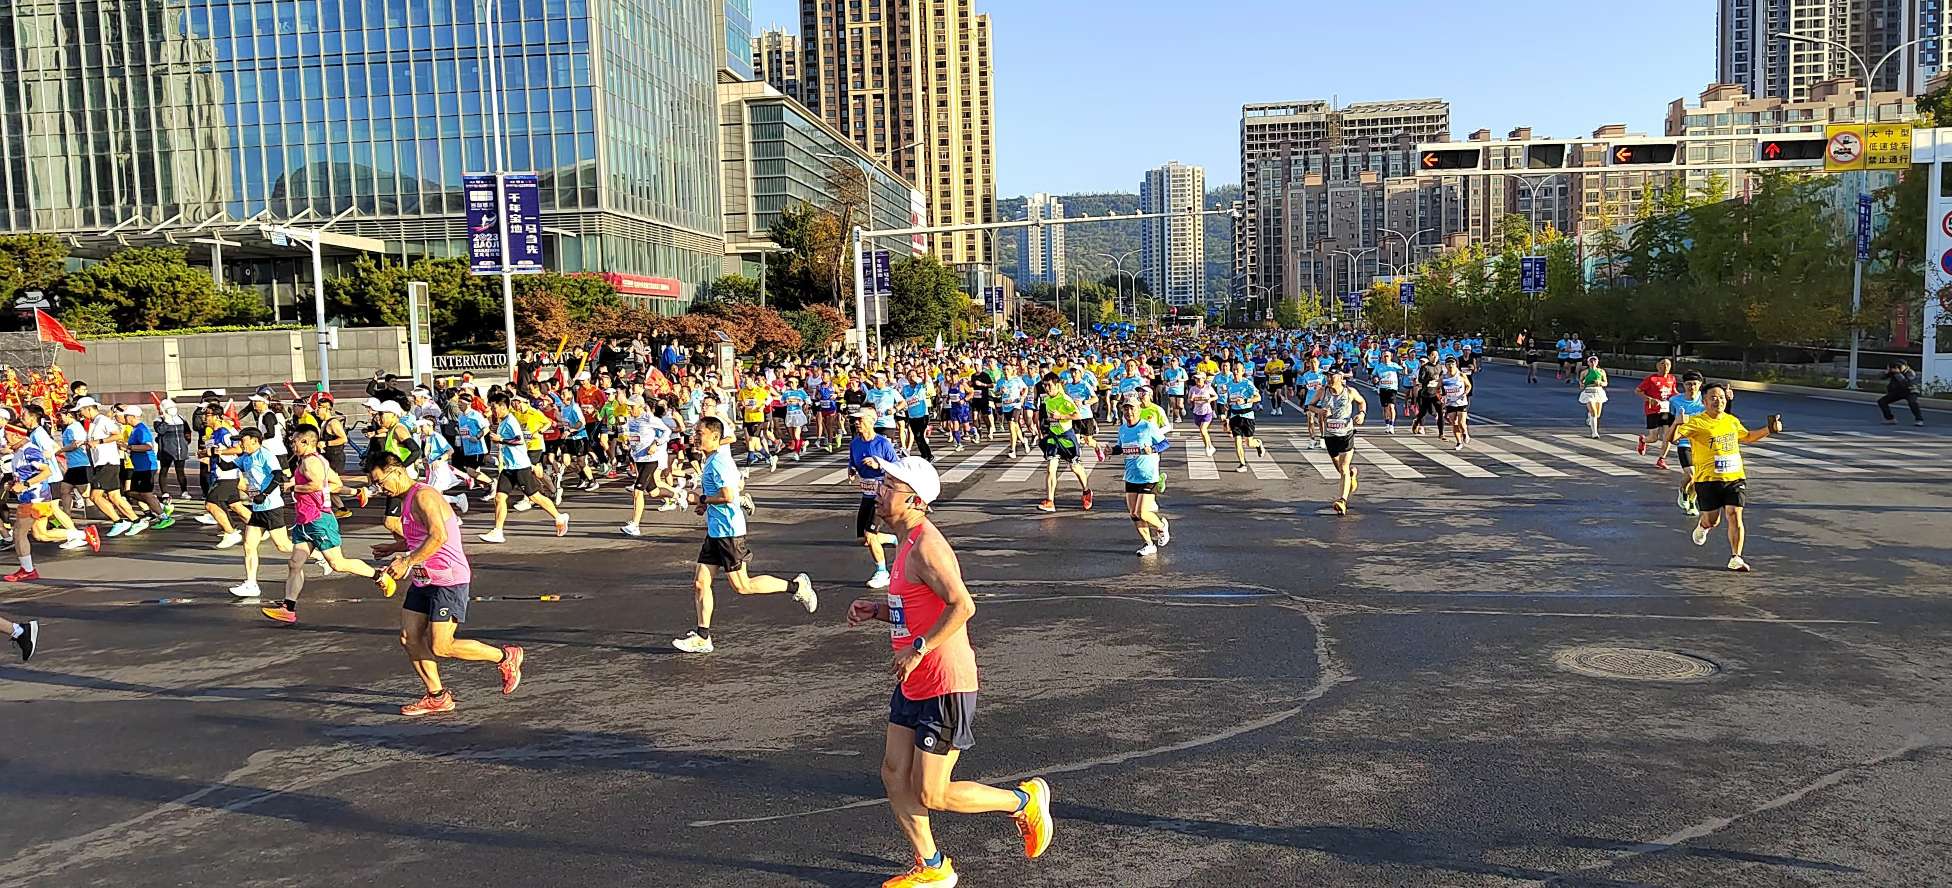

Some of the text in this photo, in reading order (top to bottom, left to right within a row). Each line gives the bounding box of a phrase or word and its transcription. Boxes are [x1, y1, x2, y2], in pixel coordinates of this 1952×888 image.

[1869, 128, 1910, 138] 大中型
[1868, 155, 1909, 164] 禁止通行
[432, 354, 522, 368] INTERNATIO
